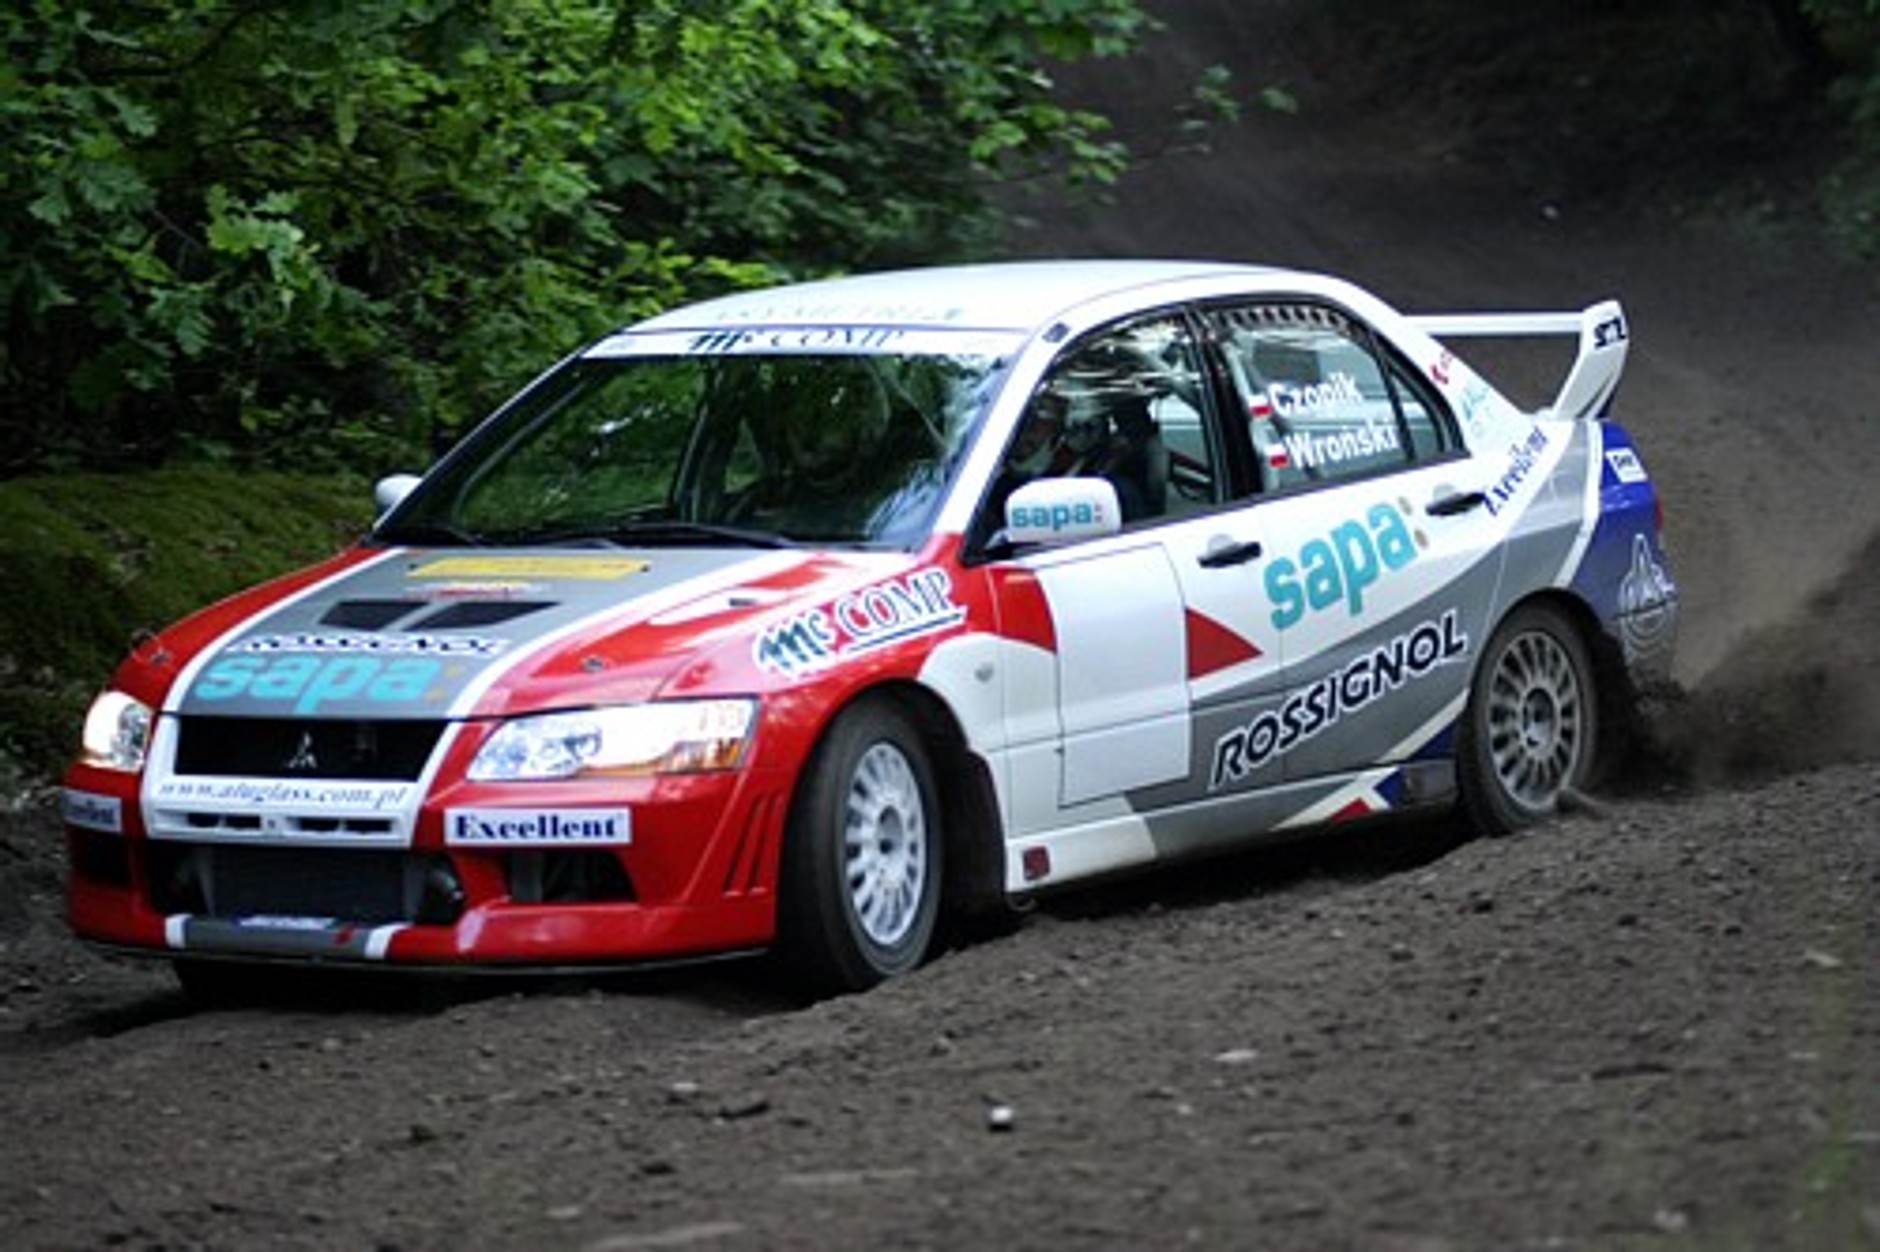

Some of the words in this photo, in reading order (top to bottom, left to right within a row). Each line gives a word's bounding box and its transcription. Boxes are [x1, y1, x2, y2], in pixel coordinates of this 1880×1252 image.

[838, 570, 950, 637] COMP
[1207, 609, 1467, 791] ROSSIGNOL
[455, 814, 617, 840] Excellent
